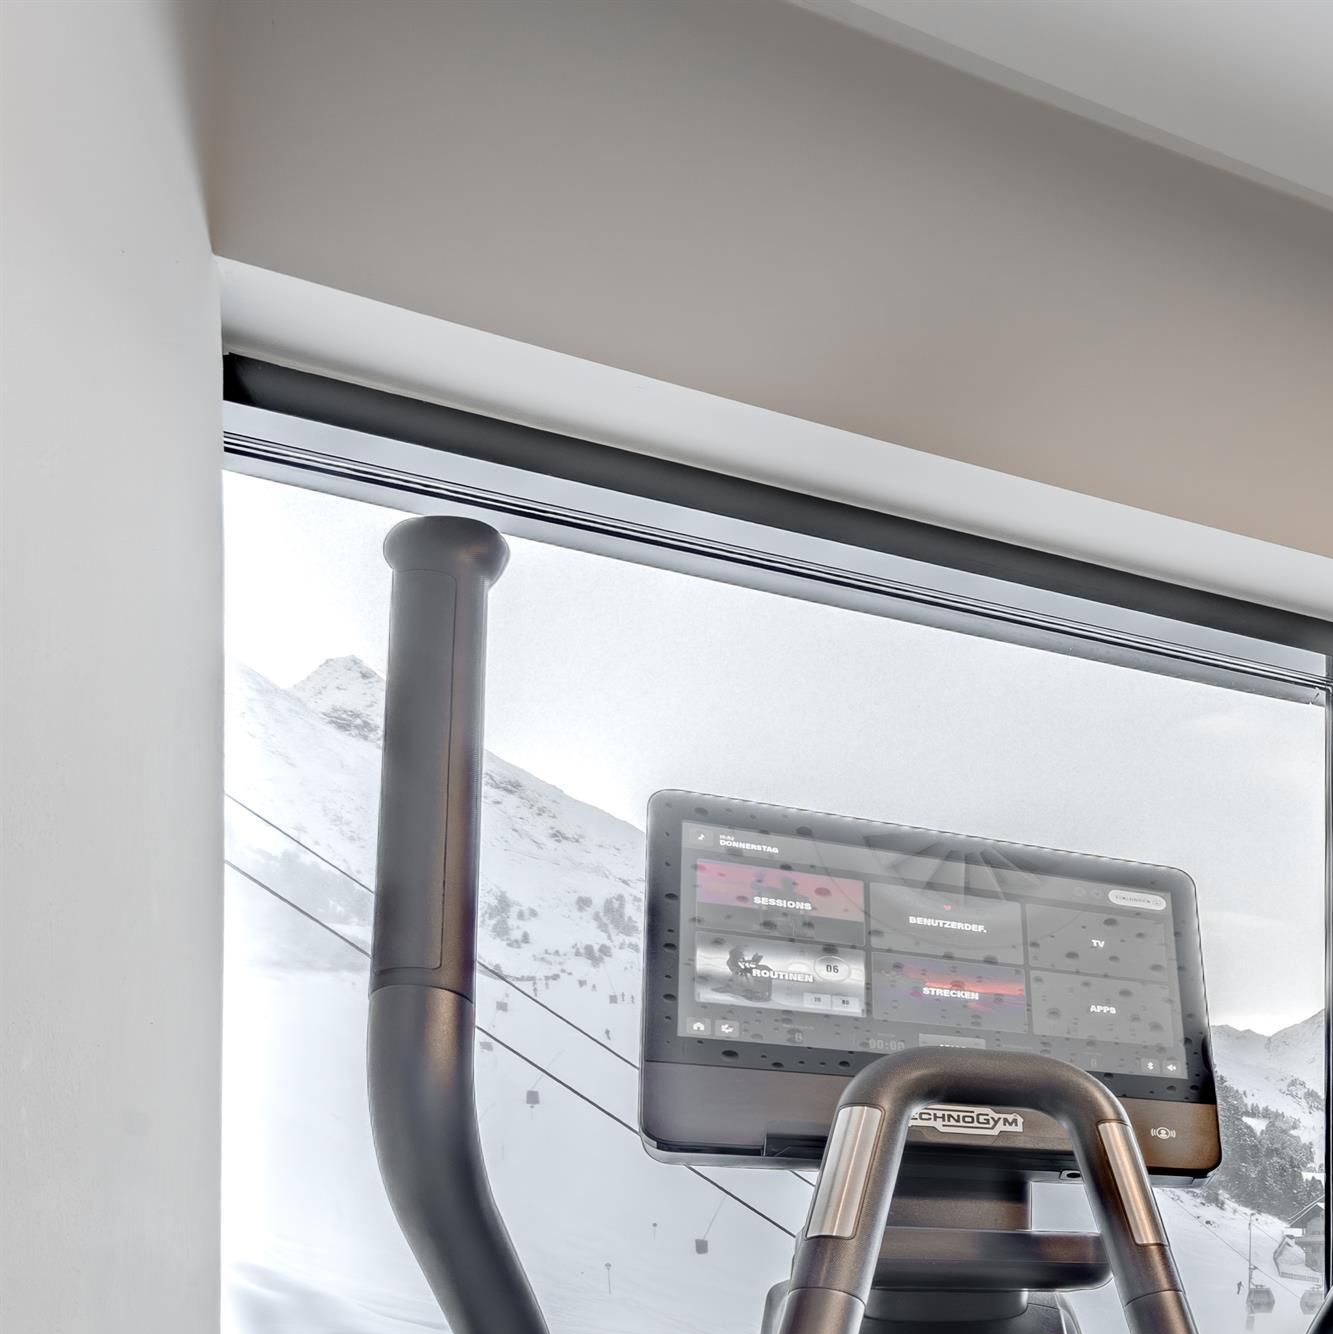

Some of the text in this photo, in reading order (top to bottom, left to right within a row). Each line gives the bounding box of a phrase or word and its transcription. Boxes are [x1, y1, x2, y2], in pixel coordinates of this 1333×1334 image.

[753, 896, 812, 911] SESSIONS
[908, 915, 988, 933] BENUTZERDEF.
[1091, 939, 1105, 948] TV
[752, 968, 814, 983] ROUTINEN
[922, 987, 979, 1000] STRECKEN
[1089, 1004, 1117, 1014] APPS
[909, 1107, 1019, 1130] CHNOGYM
